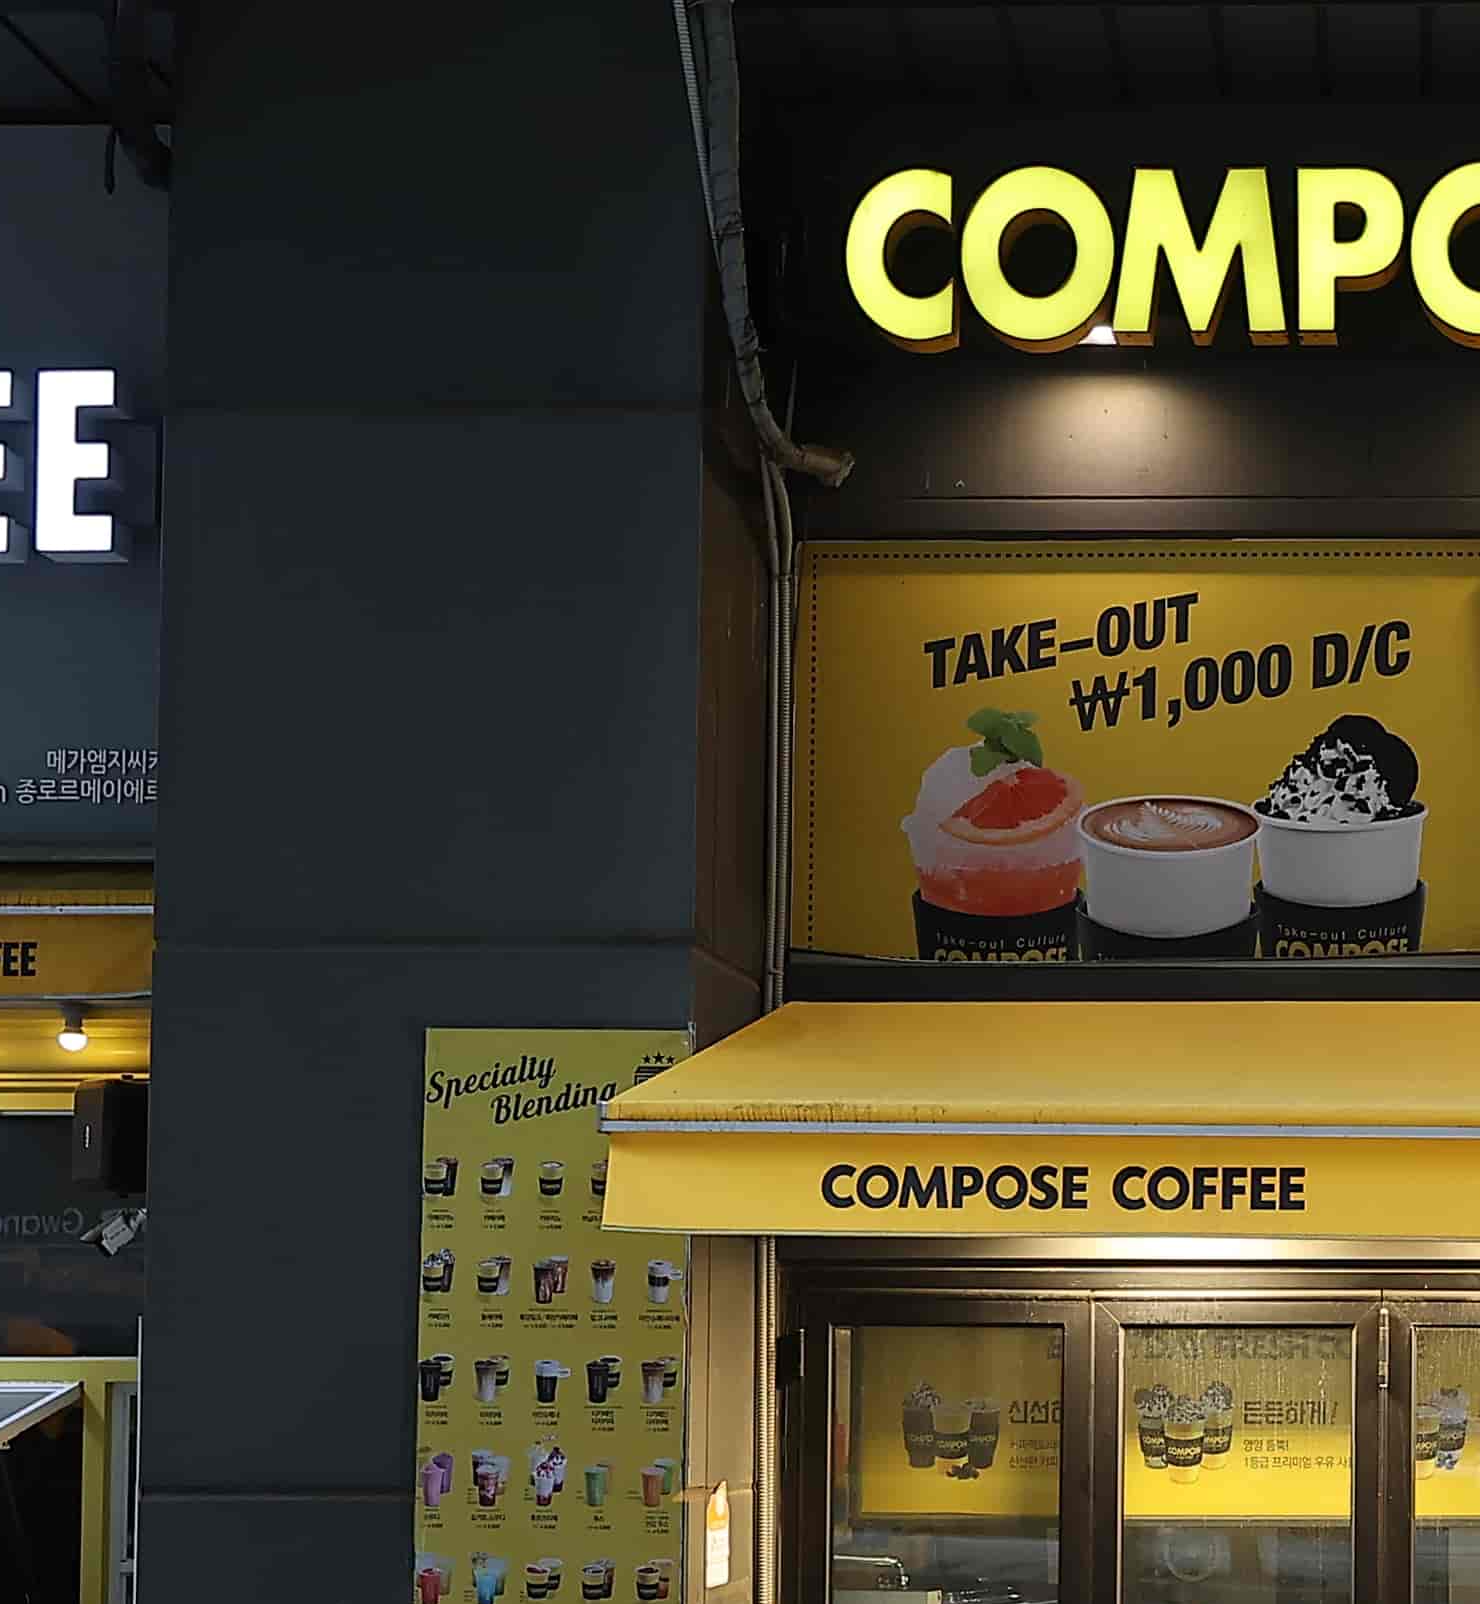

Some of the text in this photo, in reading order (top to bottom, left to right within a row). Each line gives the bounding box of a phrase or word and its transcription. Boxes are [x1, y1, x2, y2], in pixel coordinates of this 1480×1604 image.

[1069, 620, 1411, 731] ₩1,000 D/C
[426, 1055, 557, 1109] Specialty
[822, 1164, 1306, 1211] COMPOSE COFFEE
